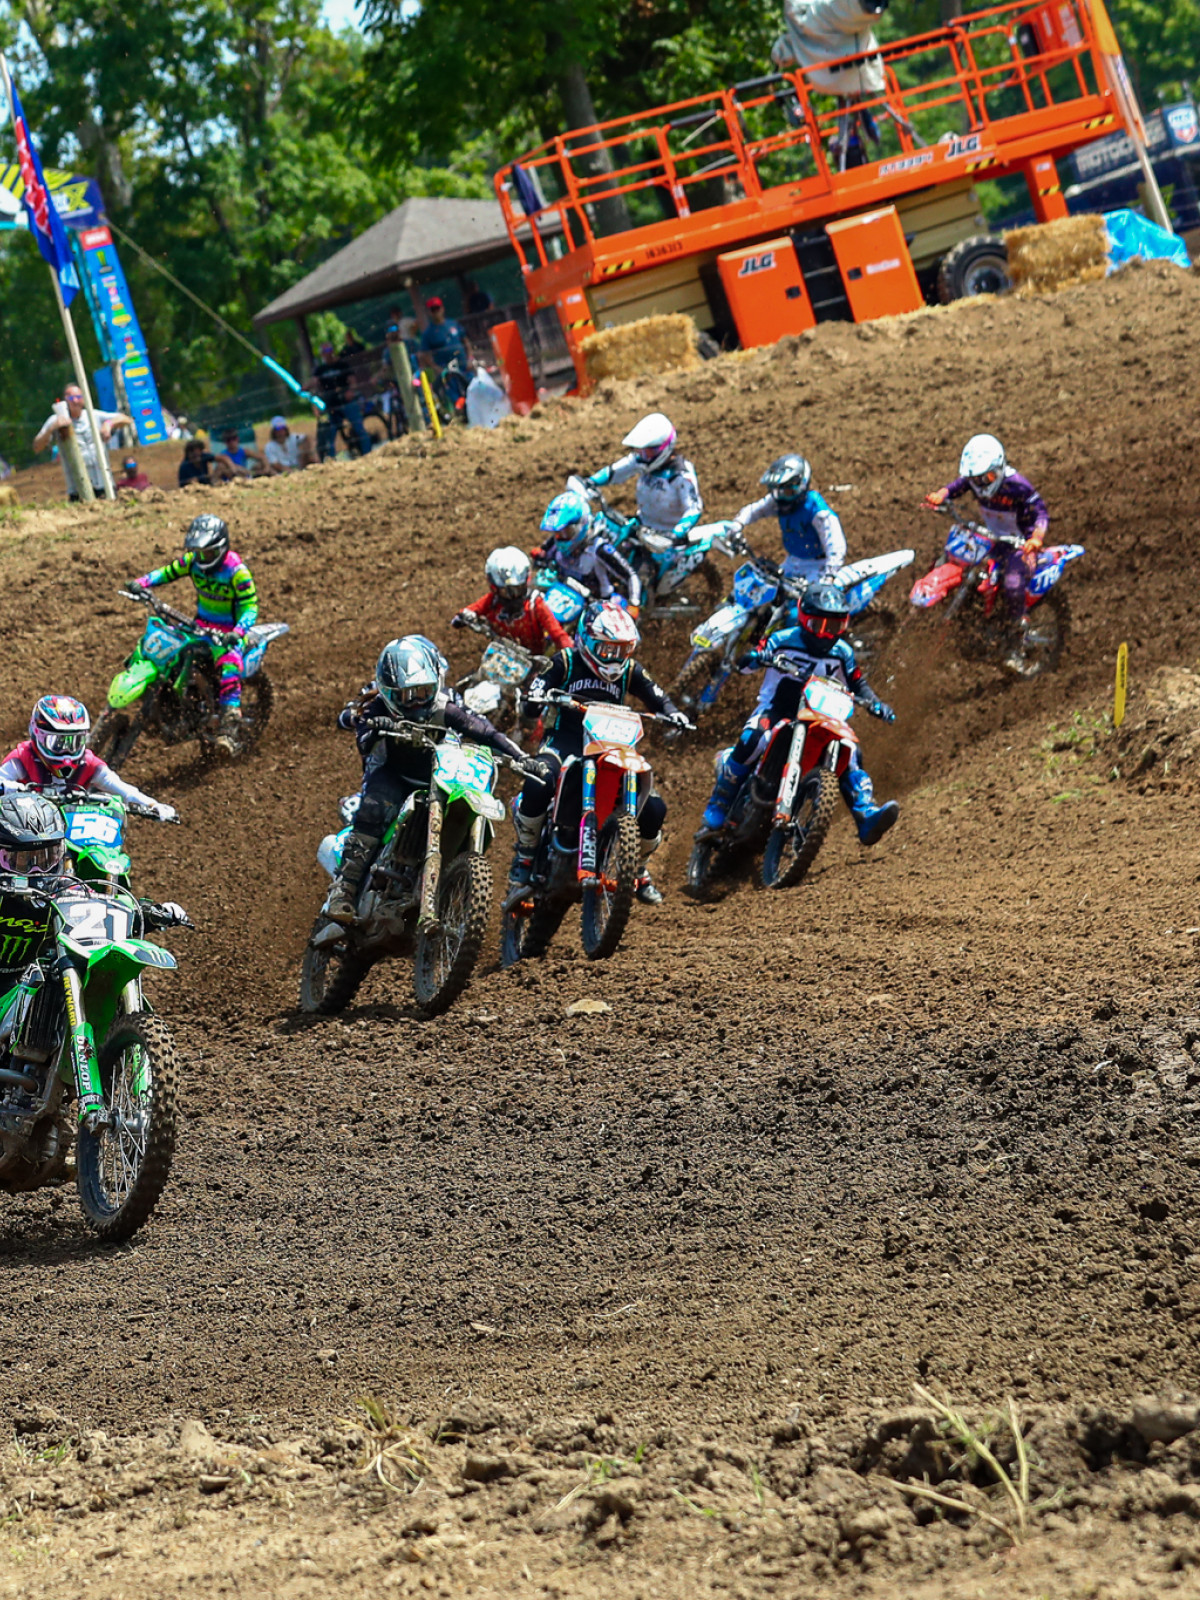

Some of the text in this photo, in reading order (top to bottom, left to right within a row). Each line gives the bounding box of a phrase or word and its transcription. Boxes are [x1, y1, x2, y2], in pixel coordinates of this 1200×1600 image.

[944, 135, 981, 162] JLG
[738, 251, 776, 277] JLG
[70, 812, 119, 845] 56
[69, 902, 128, 942] 21
[63, 976, 77, 1027] REYNARD
